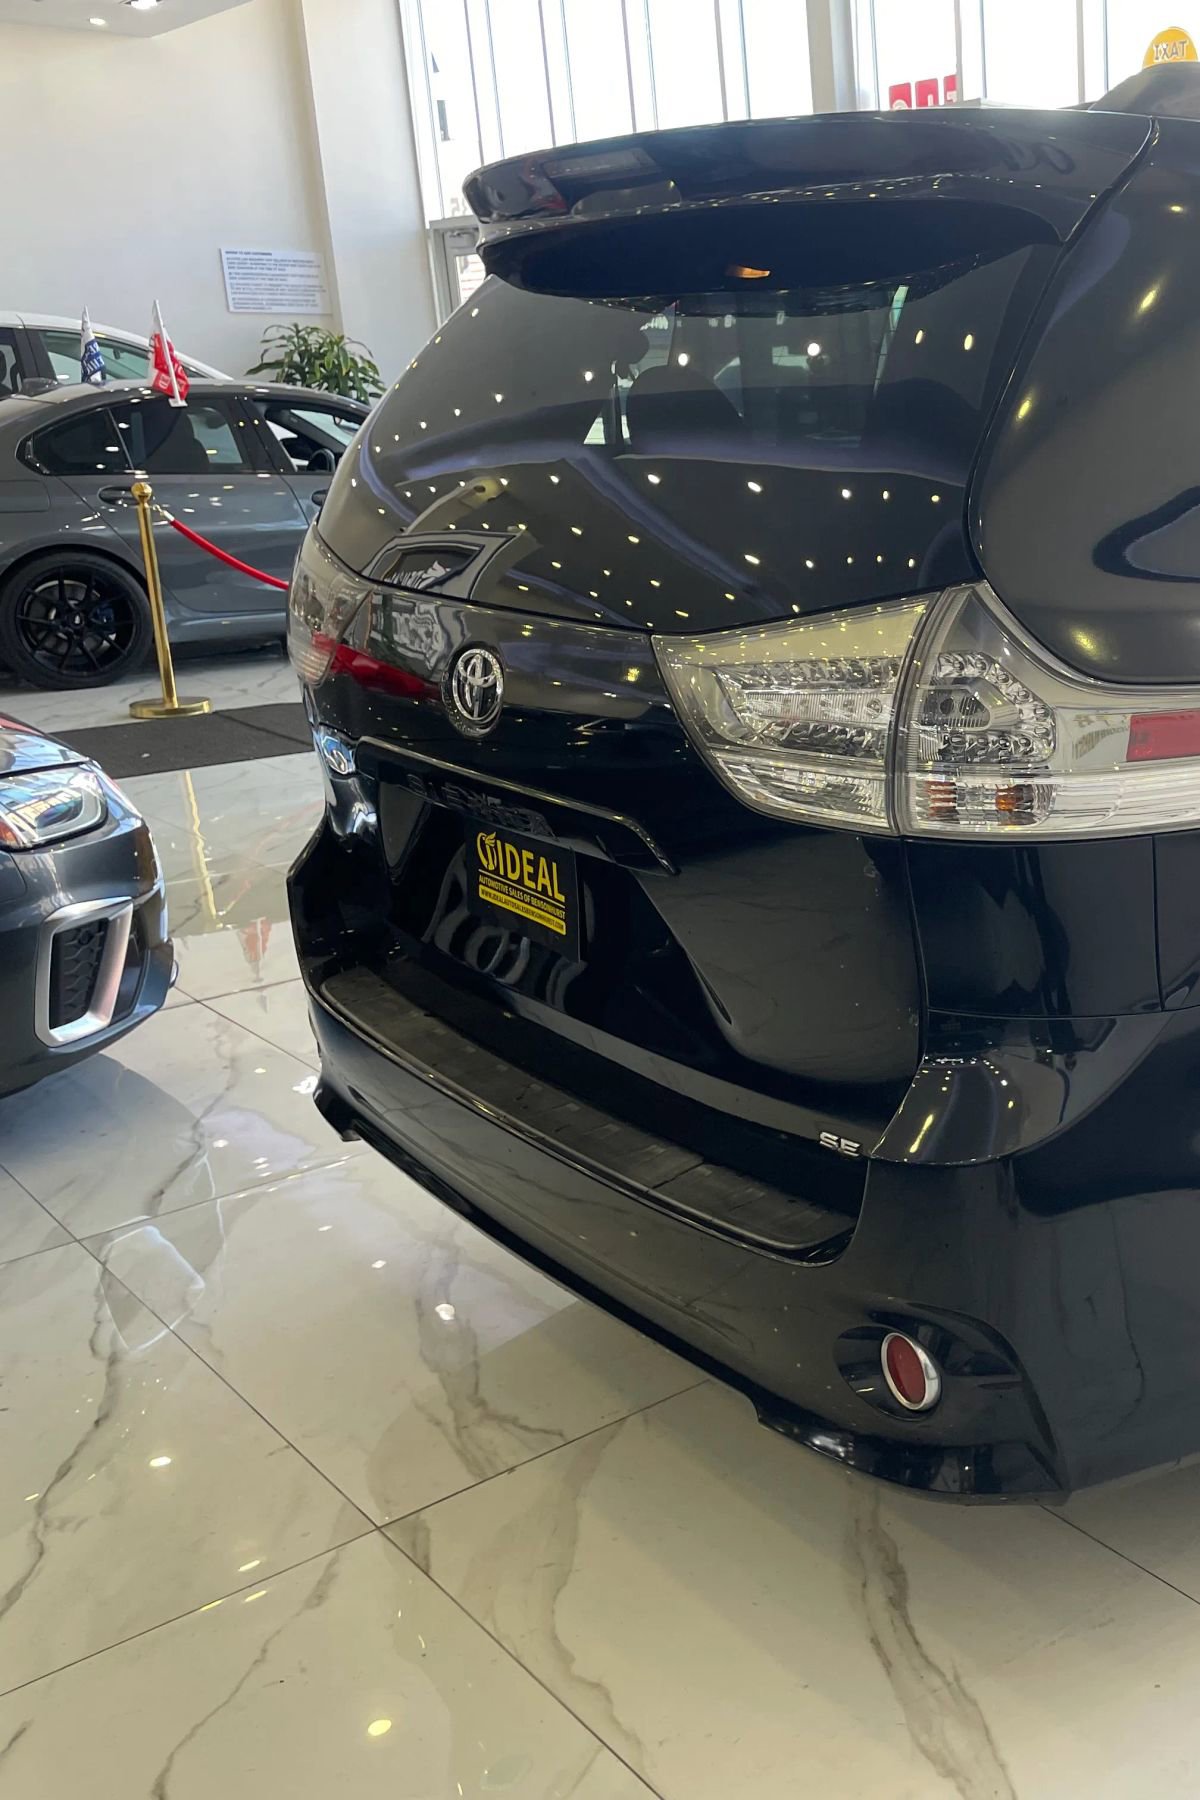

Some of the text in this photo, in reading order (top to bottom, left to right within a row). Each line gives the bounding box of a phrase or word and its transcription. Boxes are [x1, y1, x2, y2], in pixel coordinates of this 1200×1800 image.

[496, 840, 565, 904] IDEAL
[479, 874, 509, 895] AUTOMOTIVE
[508, 886, 524, 901] SALES
[819, 1131, 861, 1157] SE
